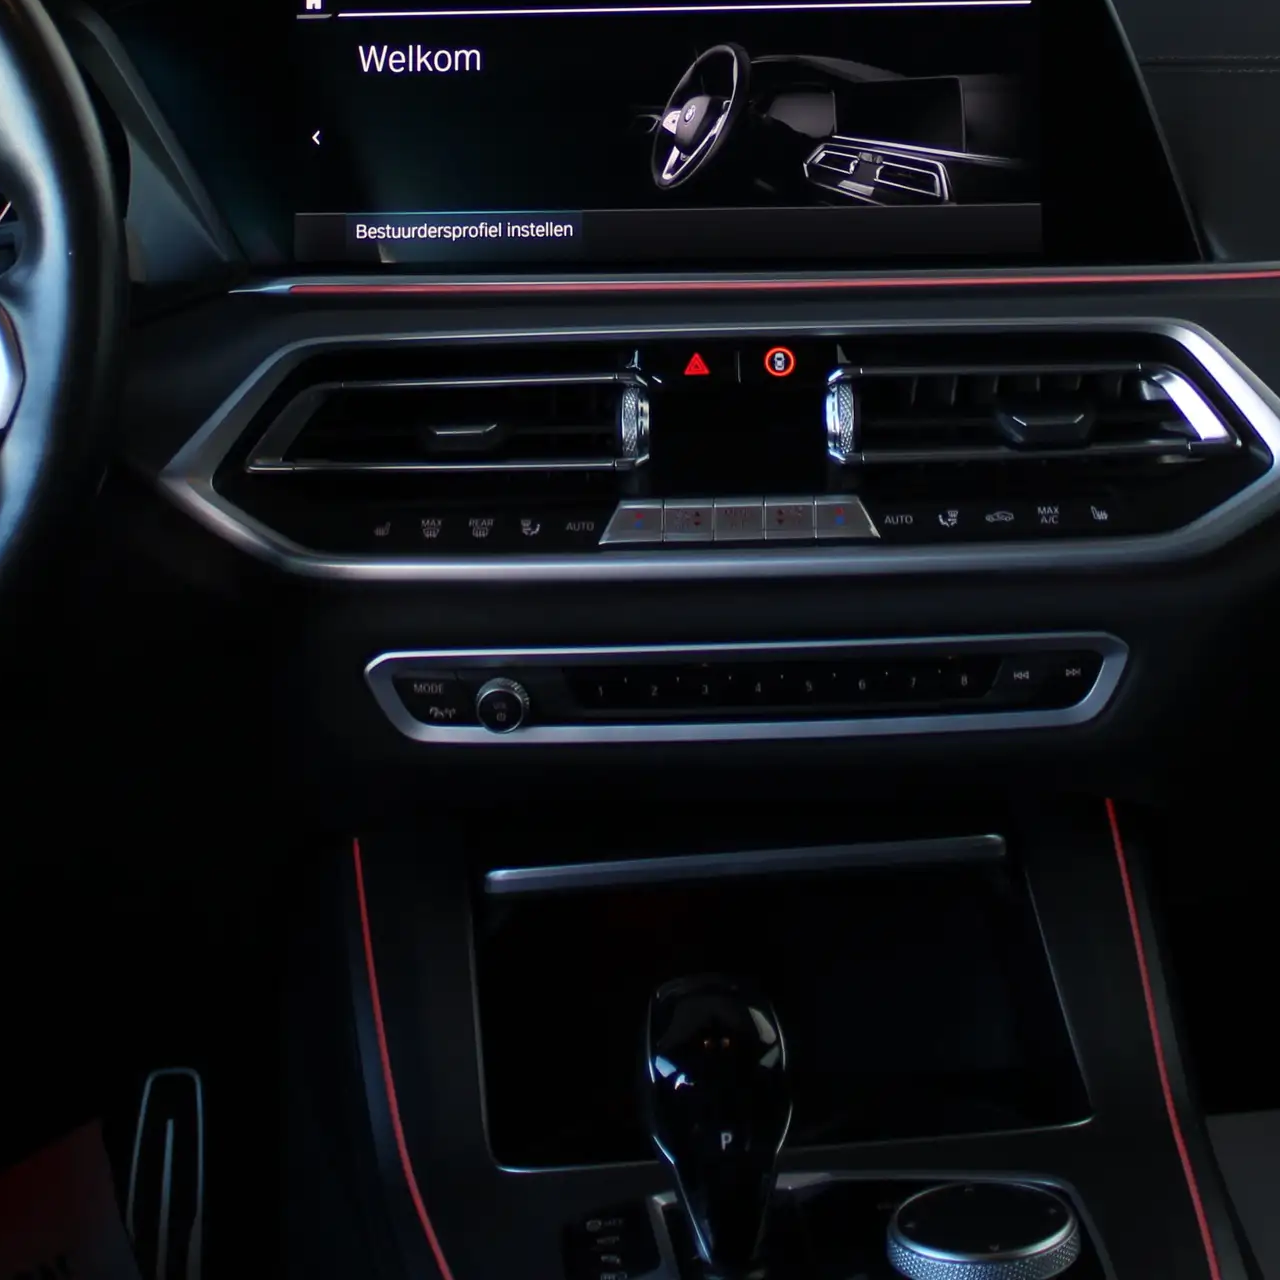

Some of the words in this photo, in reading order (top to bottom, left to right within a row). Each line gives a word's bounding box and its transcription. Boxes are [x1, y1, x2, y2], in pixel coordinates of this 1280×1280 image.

[357, 44, 482, 74] Welkom
[356, 222, 502, 241] Bestuurdersprofiel
[507, 222, 573, 237] instellen
[1037, 505, 1060, 515] MAX
[884, 514, 913, 525] AUTO
[1039, 515, 1060, 525] A/C
[565, 521, 595, 532] AUTO
[413, 682, 444, 694] MODE
[720, 1131, 734, 1151] P
